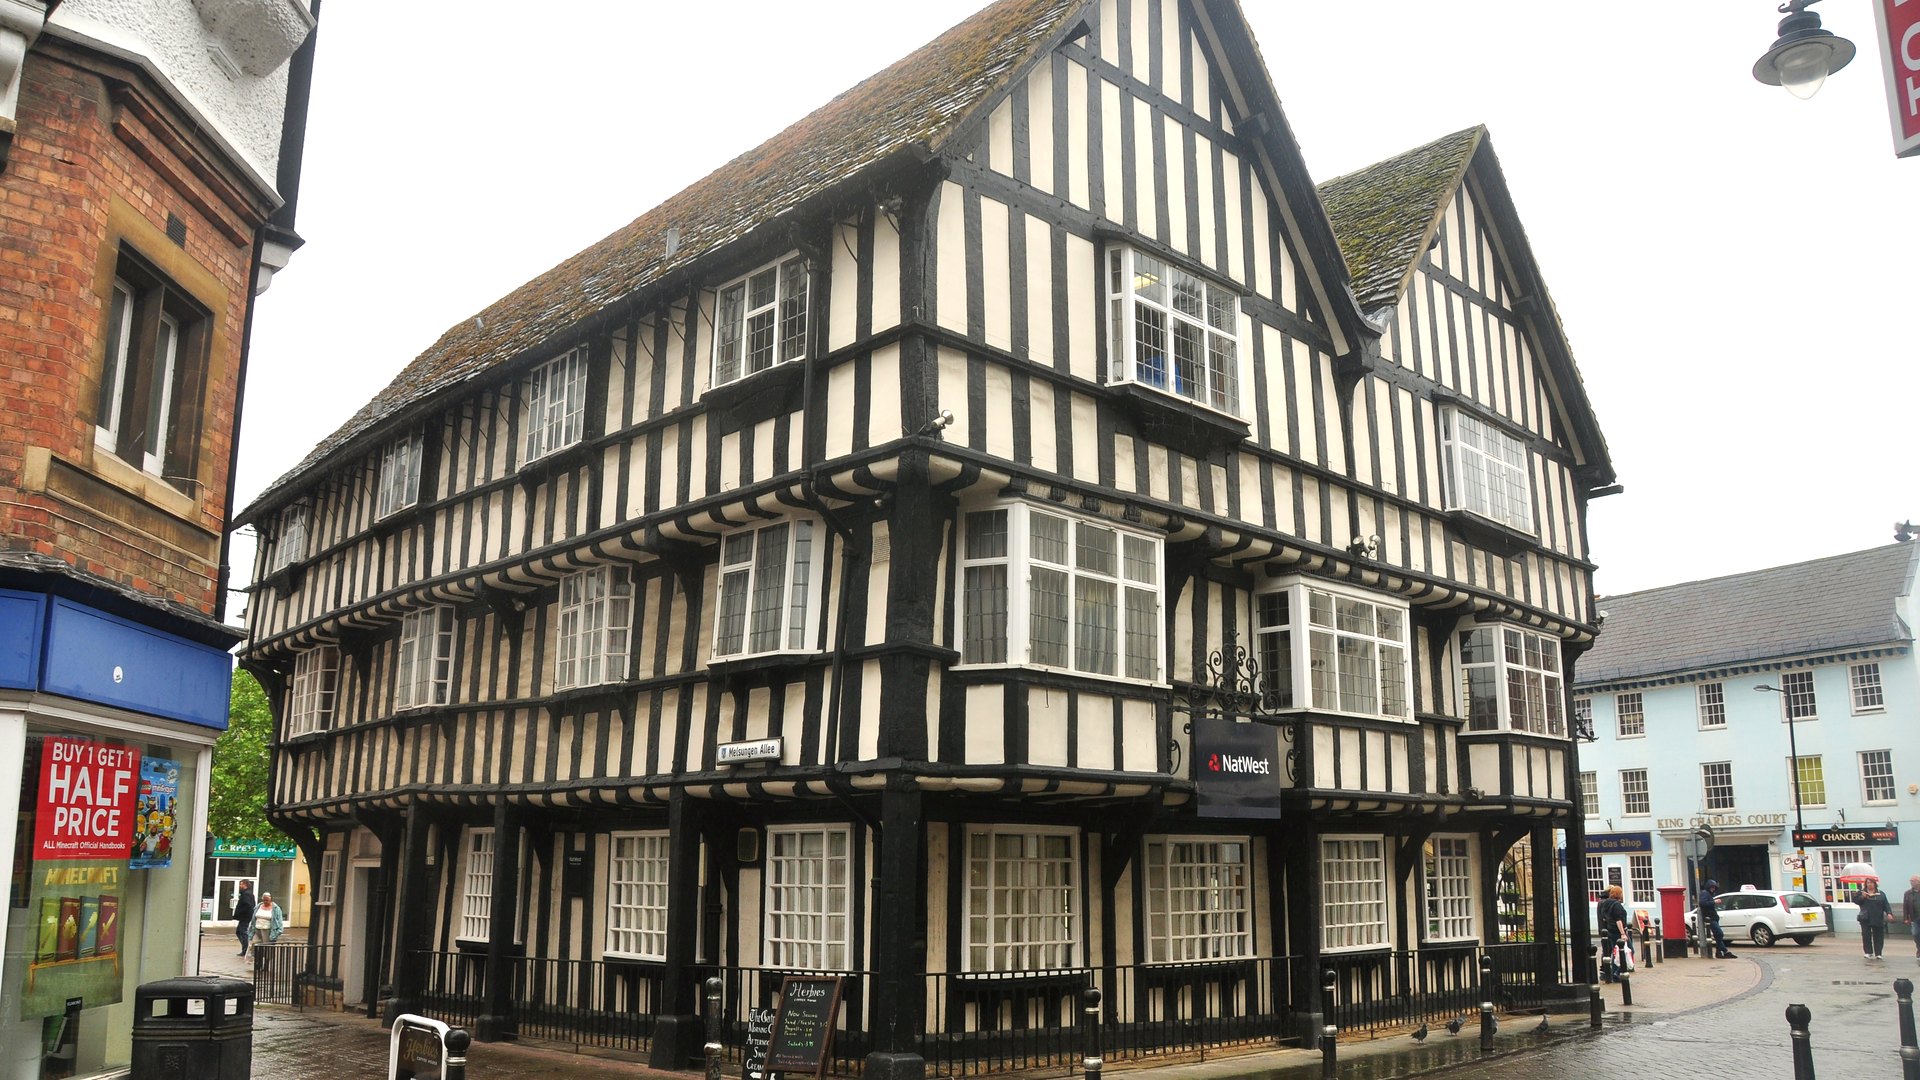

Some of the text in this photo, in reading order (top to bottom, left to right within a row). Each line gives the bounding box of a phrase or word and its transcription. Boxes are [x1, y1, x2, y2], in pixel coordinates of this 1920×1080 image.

[53, 742, 133, 768] BUY 1 GET 1
[728, 743, 775, 758] Melsungen Allee
[1222, 754, 1270, 775] NatWest
[49, 764, 131, 807] HALF
[54, 807, 121, 836] PRICE
[1657, 814, 1787, 829] KING CHARLES COURT
[43, 840, 55, 849] ALL
[56, 841, 79, 849] Minecraft
[79, 841, 98, 849] Official
[1601, 840, 1618, 848] Gas
[1620, 839, 1642, 848] Shop
[1822, 832, 1866, 841] CHANCERS
[790, 982, 825, 998] Herbies
[403, 1038, 438, 1062] Herbies
